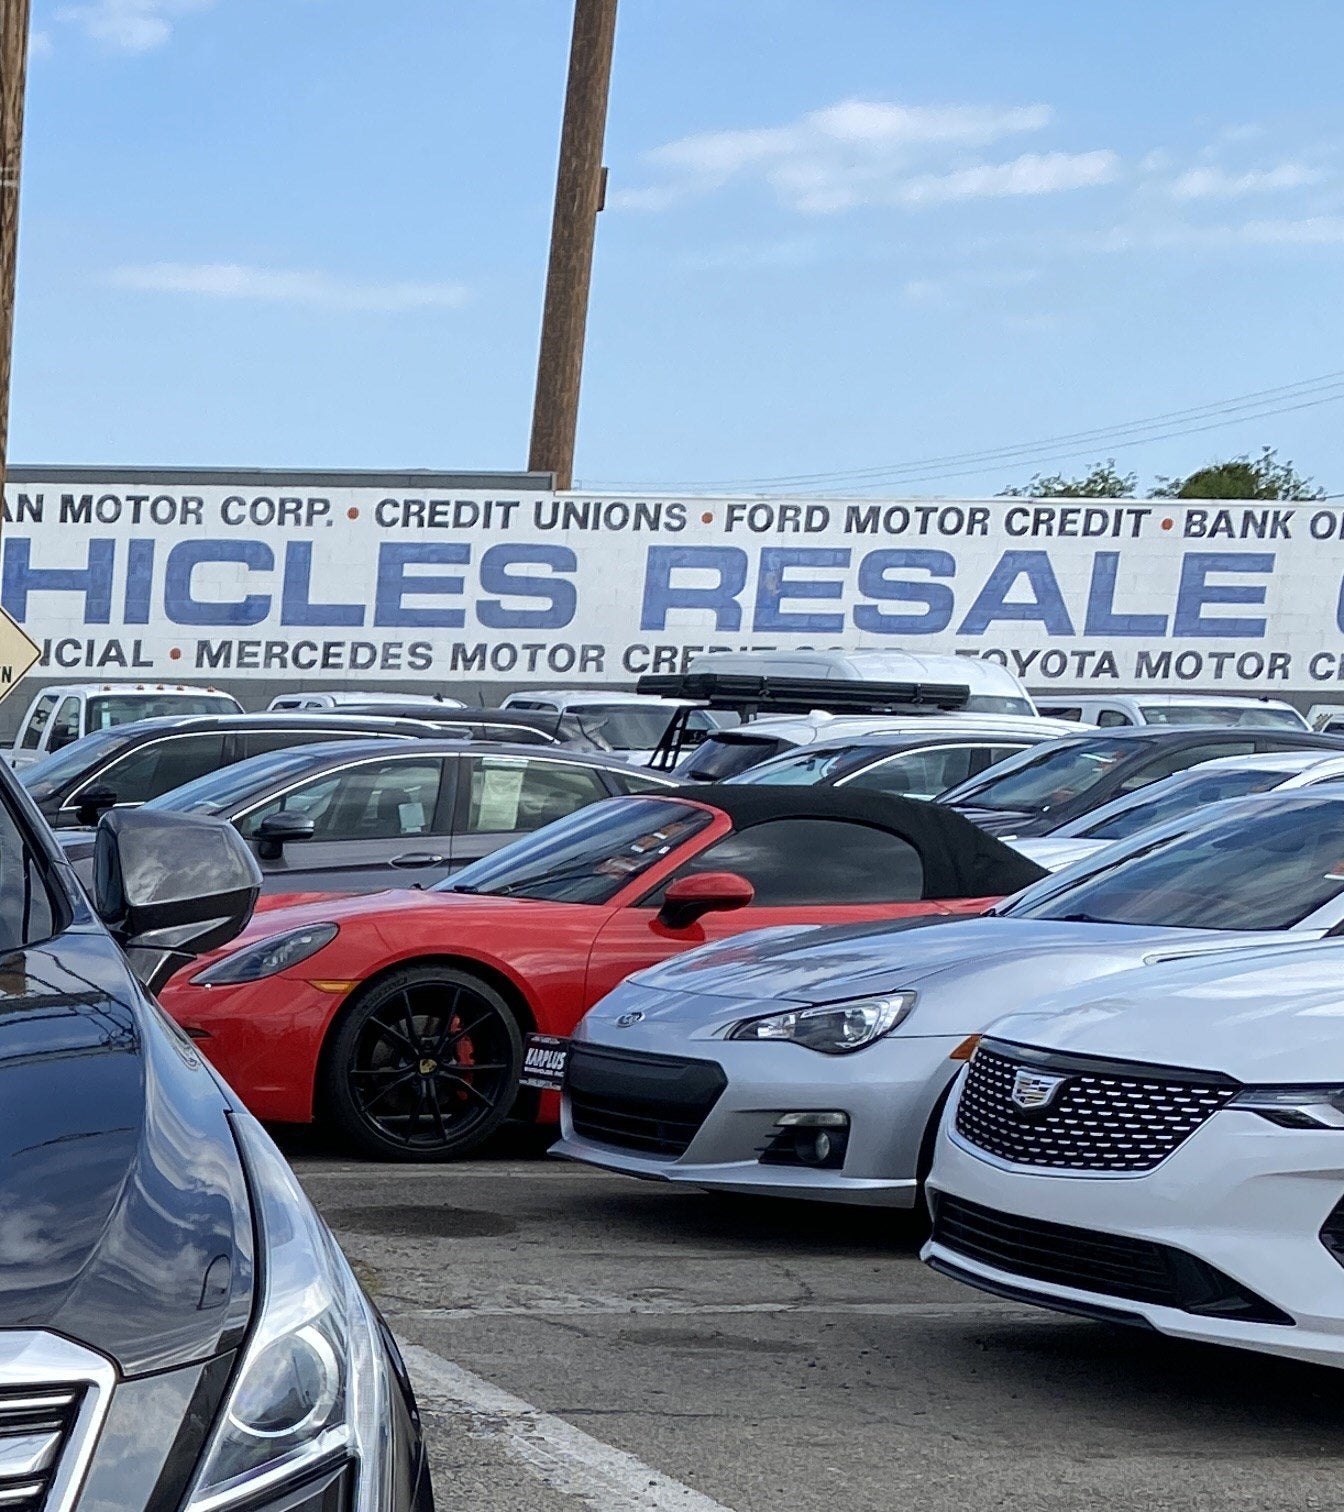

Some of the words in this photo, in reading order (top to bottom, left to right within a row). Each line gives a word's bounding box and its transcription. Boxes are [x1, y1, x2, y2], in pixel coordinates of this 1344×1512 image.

[59, 495, 205, 525] MOTOR
[220, 496, 334, 528] CORP.
[375, 498, 520, 530] CREDIT
[534, 501, 688, 532] UNIONS
[724, 504, 831, 533] FORD
[843, 506, 991, 536] MOTOR
[1005, 507, 1151, 537] CREDIT
[1183, 509, 1297, 539] BANK
[1309, 510, 1344, 541] O
[640, 544, 1277, 639] RESALE
[195, 640, 433, 671] MERCEDES
[449, 643, 606, 673] MOTOR
[1134, 650, 1292, 681] MOTOR
[525, 1048, 567, 1070] KARPLUS
